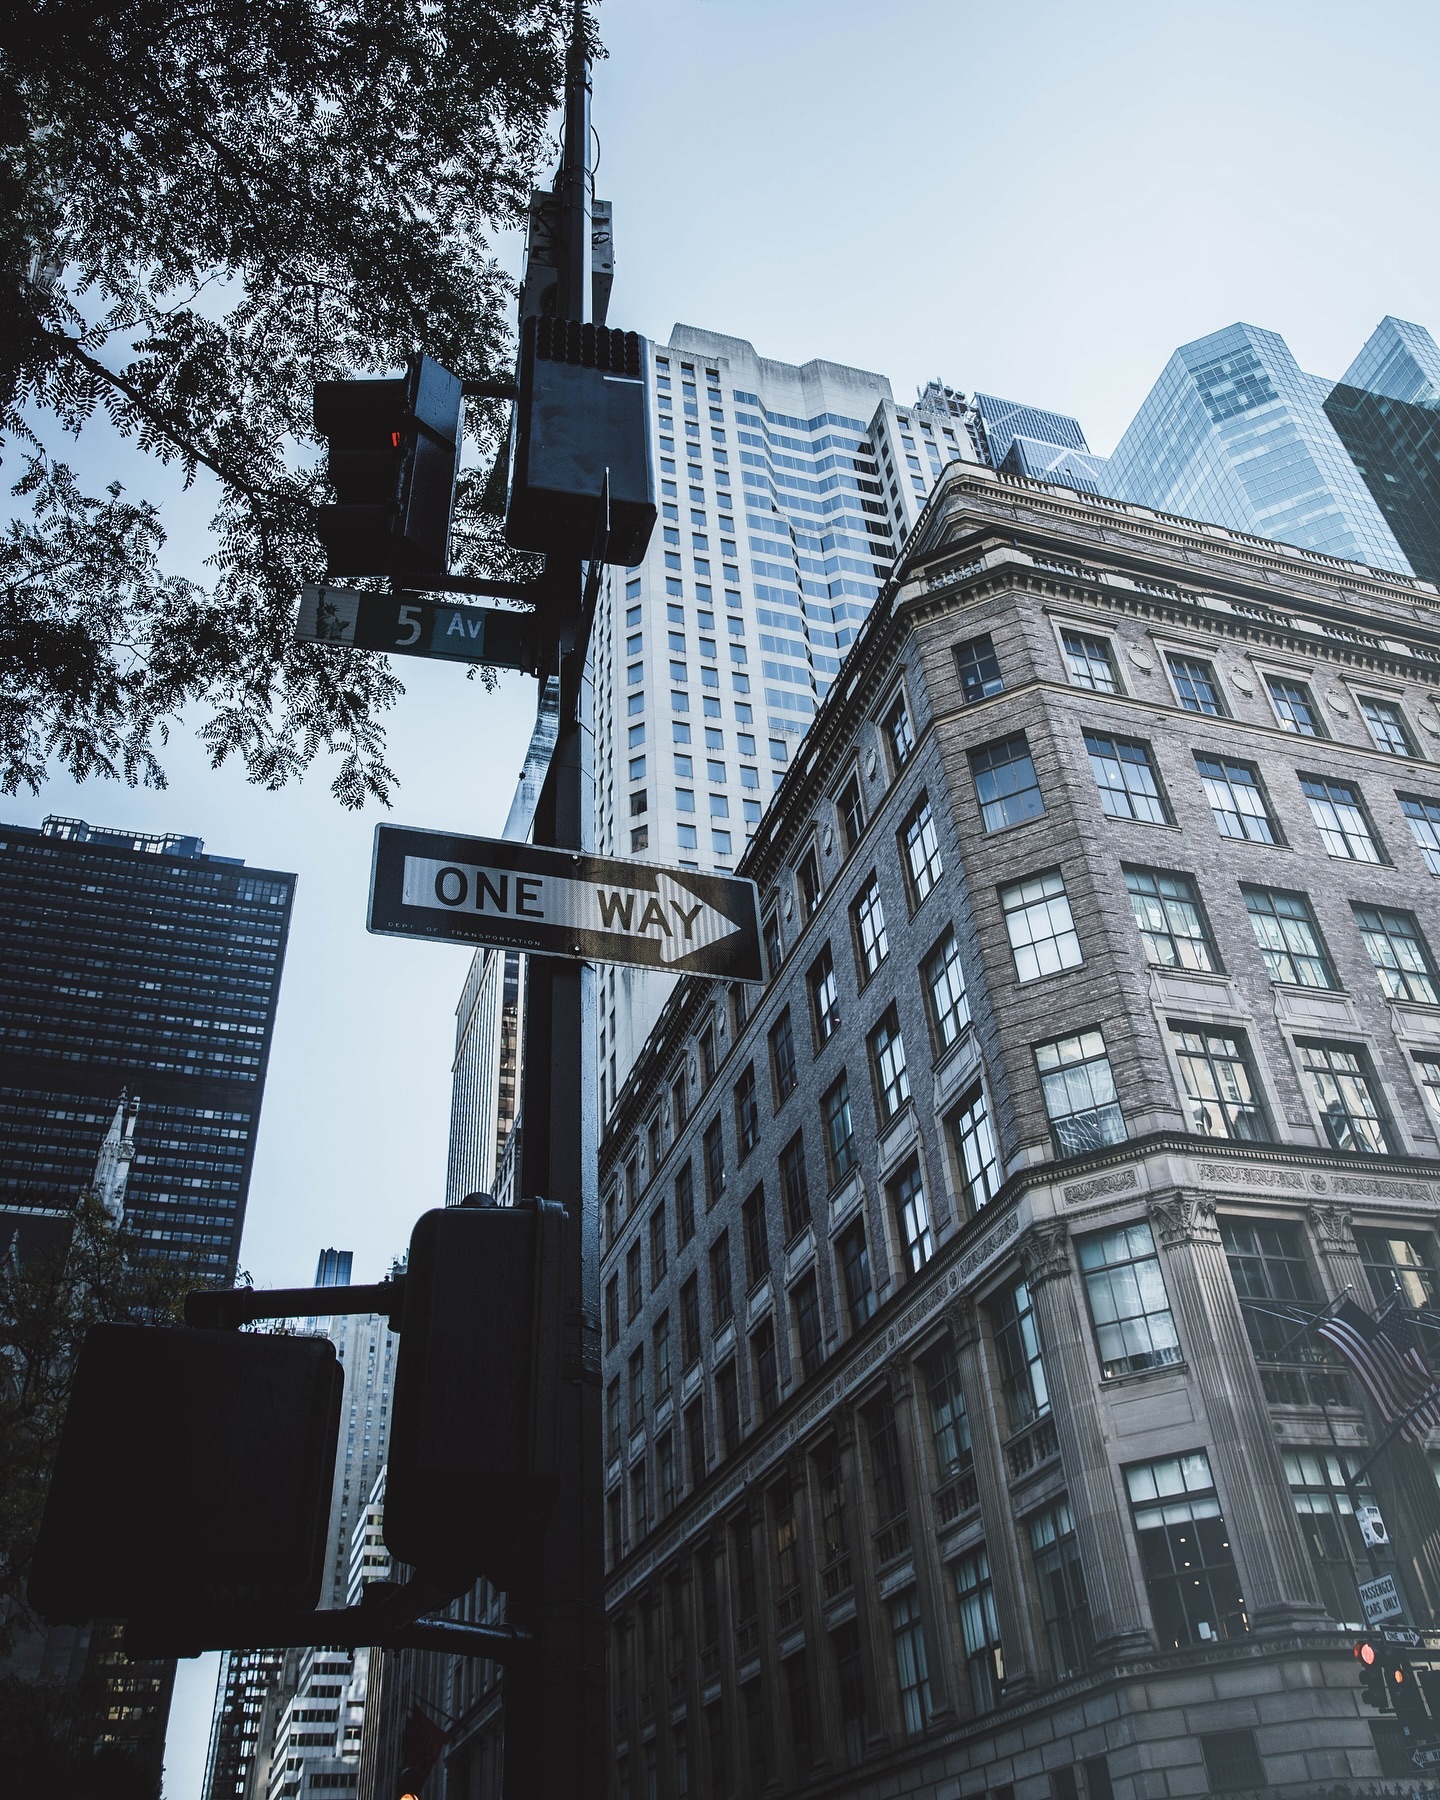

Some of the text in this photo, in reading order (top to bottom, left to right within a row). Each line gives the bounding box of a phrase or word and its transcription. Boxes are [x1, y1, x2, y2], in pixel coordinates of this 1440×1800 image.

[395, 604, 483, 646] 5 Av
[434, 866, 704, 940] ONE WAY
[387, 921, 415, 930] DEPT
[450, 929, 542, 947] TRANSPORTATION
[1361, 1579, 1395, 1601] PASSENGER
[1365, 1595, 1399, 1619] CARS ONLY
[1386, 1631, 1417, 1642] ONE WAY
[1415, 1752, 1429, 1764] ONE
